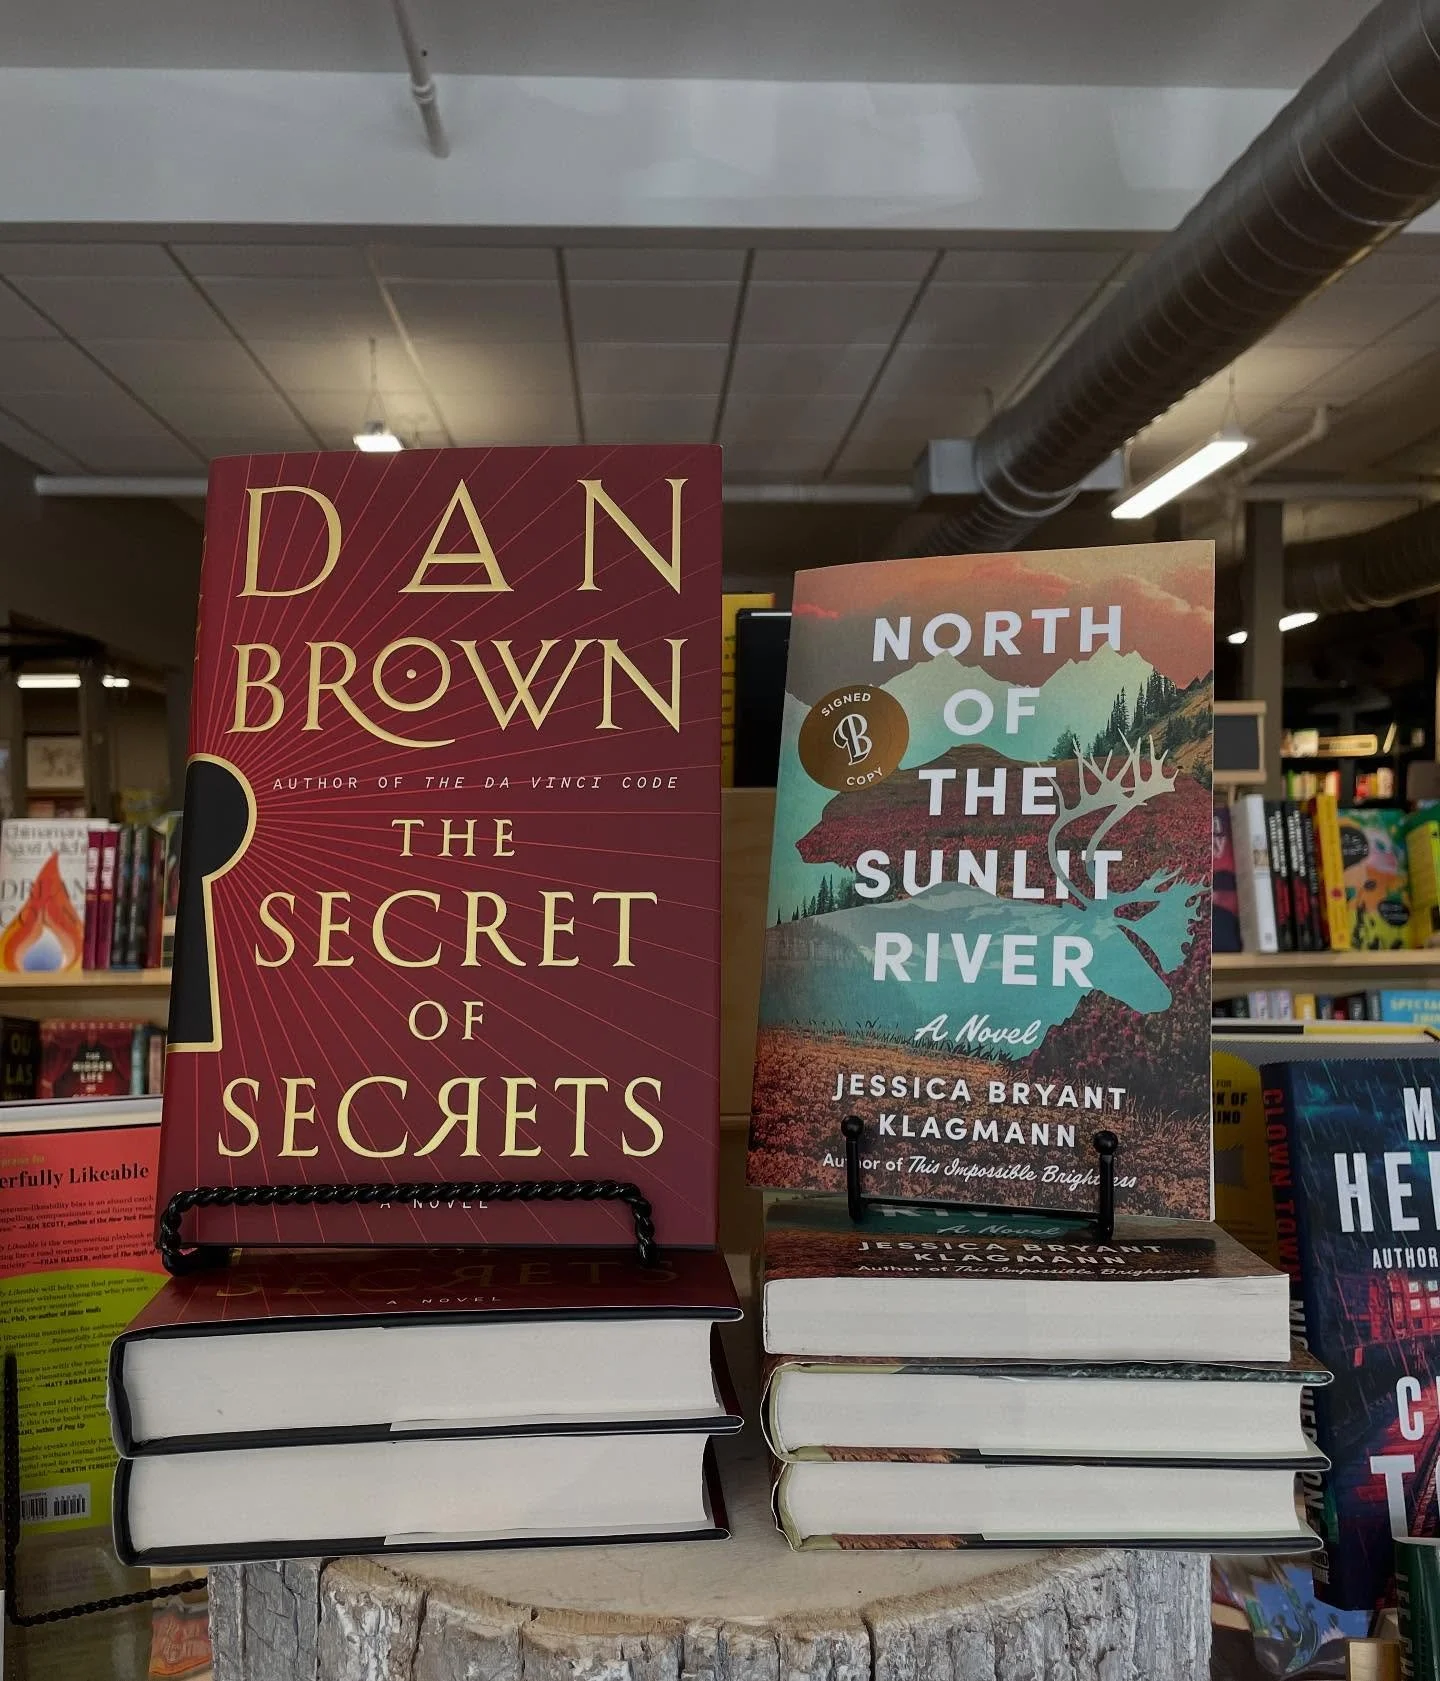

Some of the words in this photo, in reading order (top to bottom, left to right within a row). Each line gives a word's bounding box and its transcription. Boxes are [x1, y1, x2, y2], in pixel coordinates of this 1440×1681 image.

[236, 478, 689, 598] DAN
[871, 605, 1122, 662] NORTH
[224, 636, 689, 748] BROWN
[821, 691, 872, 717] SIGNED
[943, 687, 1041, 735] OF
[272, 777, 359, 790] AUTHOR
[377, 777, 404, 789] OF
[424, 776, 466, 789] THE
[484, 776, 511, 789] DA
[531, 775, 602, 789] VINCI
[622, 775, 680, 789] CODE
[846, 766, 884, 787] COPY
[918, 766, 1059, 816] THE
[391, 818, 516, 858] THE
[853, 849, 1123, 900] SUNLIT
[254, 889, 659, 969] SECRET
[872, 931, 1094, 989] RIVER
[408, 1000, 484, 1041] OF
[914, 1017, 949, 1042] A
[955, 1013, 1043, 1046] Novel
[831, 1072, 972, 1103] JESSICA
[988, 1079, 1127, 1111] BRYANT
[1231, 1091, 1248, 1106] OF
[217, 1075, 665, 1159] SECRETS
[879, 1113, 1077, 1148] KLAGMANN
[1263, 1088, 1293, 1188] CLOWN
[69, 1162, 149, 1184] Likeable
[823, 1152, 880, 1173] Auor
[884, 1157, 904, 1173] of
[907, 1155, 941, 1175] This
[944, 1157, 1037, 1182] Impossible
[1040, 1165, 1138, 1191] Brightess
[856, 1241, 1014, 1253] JESSICA
[1021, 1242, 1164, 1254] BRYANT
[936, 1224, 972, 1235] A
[978, 1224, 1064, 1236] Novel
[1276, 1198, 1304, 1282] TOWN
[857, 1263, 925, 1274] Author
[930, 1265, 949, 1273] of
[954, 1264, 991, 1275] This
[993, 1266, 1096, 1277] Impossible
[1098, 1267, 1201, 1278] Brightness
[914, 1252, 1128, 1265] KLAGMANN
[1373, 1247, 1439, 1269] AUTHOR
[421, 1295, 502, 1304] NOVEL
[1289, 1299, 1309, 1351] MIC
[1396, 1375, 1440, 1441] C
